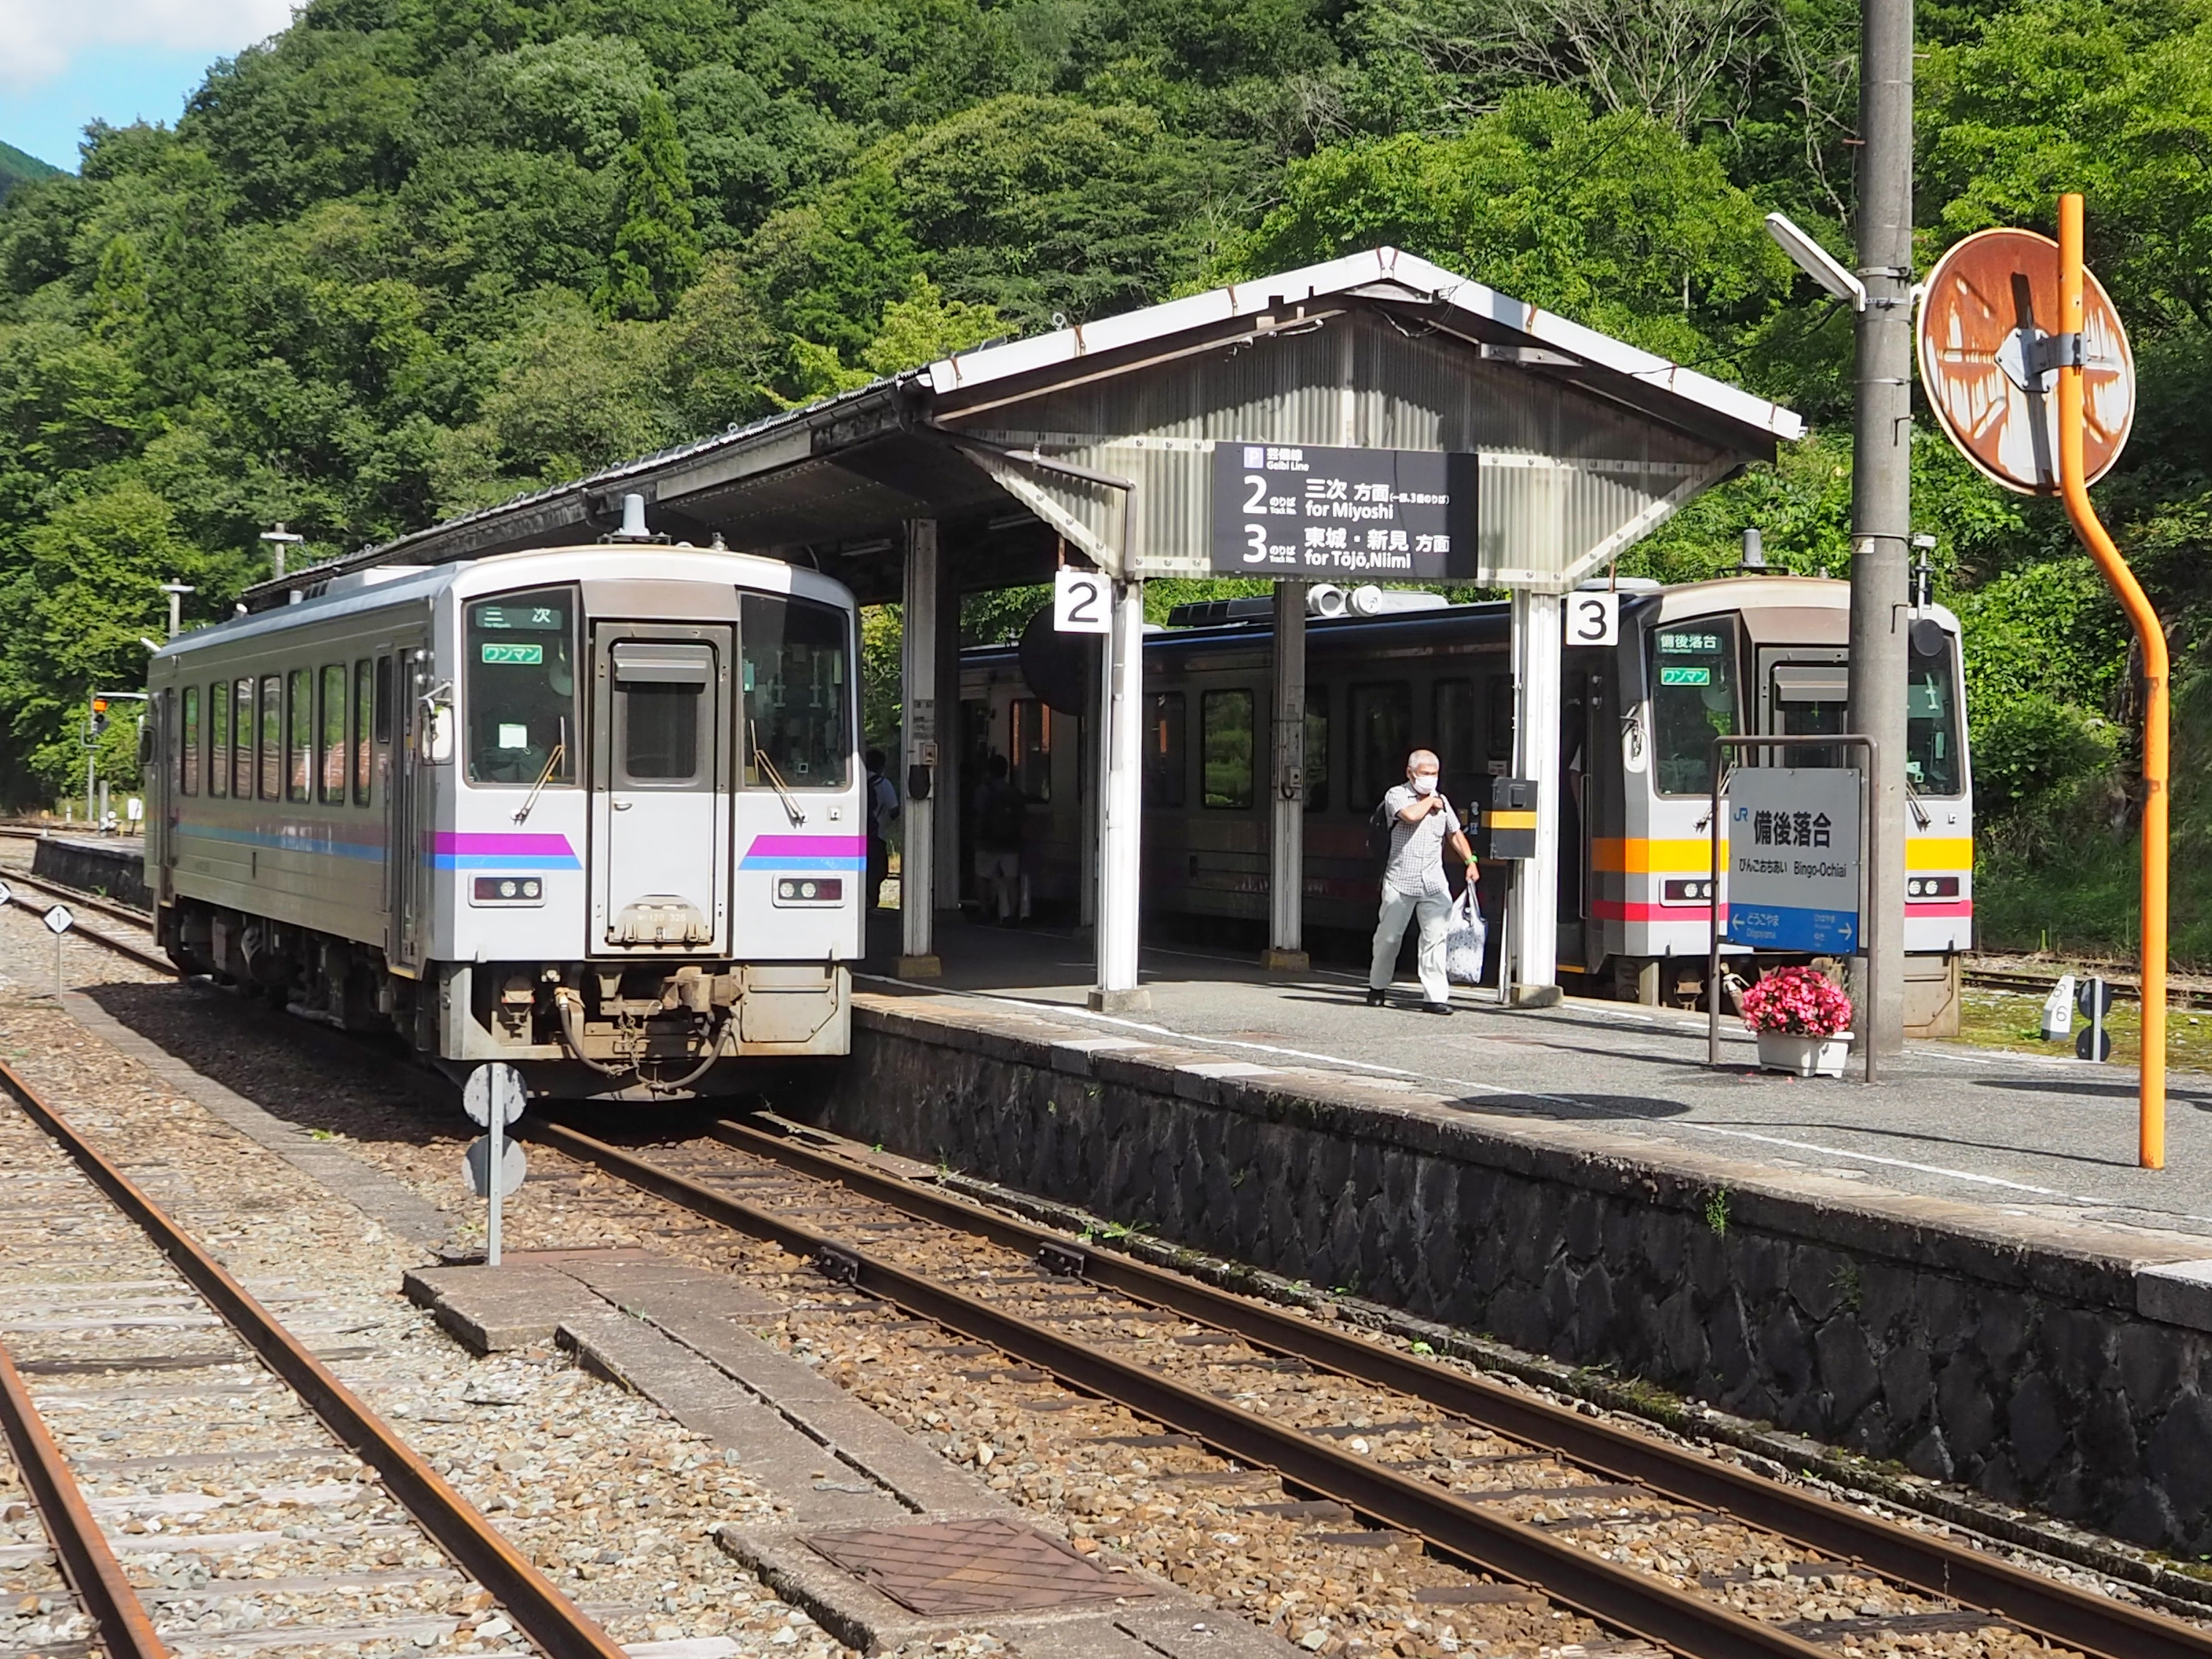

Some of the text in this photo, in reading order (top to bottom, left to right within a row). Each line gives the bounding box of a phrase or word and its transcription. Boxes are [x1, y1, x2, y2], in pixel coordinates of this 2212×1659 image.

[1242, 474, 1267, 514] 2
[1305, 478, 1347, 501] 三次
[1354, 483, 1389, 502] 方面
[1305, 500, 1394, 522] for Miyoshi
[1243, 524, 1267, 563] 3
[1415, 534, 1451, 553] 方面
[1304, 549, 1329, 566] for
[1067, 581, 1100, 623] 2
[1577, 599, 1607, 641] 3
[486, 647, 540, 661] ワンマン
[1664, 670, 1708, 683] ワンマン
[1733, 807, 1748, 822] JR
[1753, 810, 1832, 848] 備後落合
[1794, 861, 1847, 878] Bingo-Ochiai
[56, 913, 61, 926] 1
[650, 914, 665, 922] 120
[2056, 1006, 2067, 1022] 6
